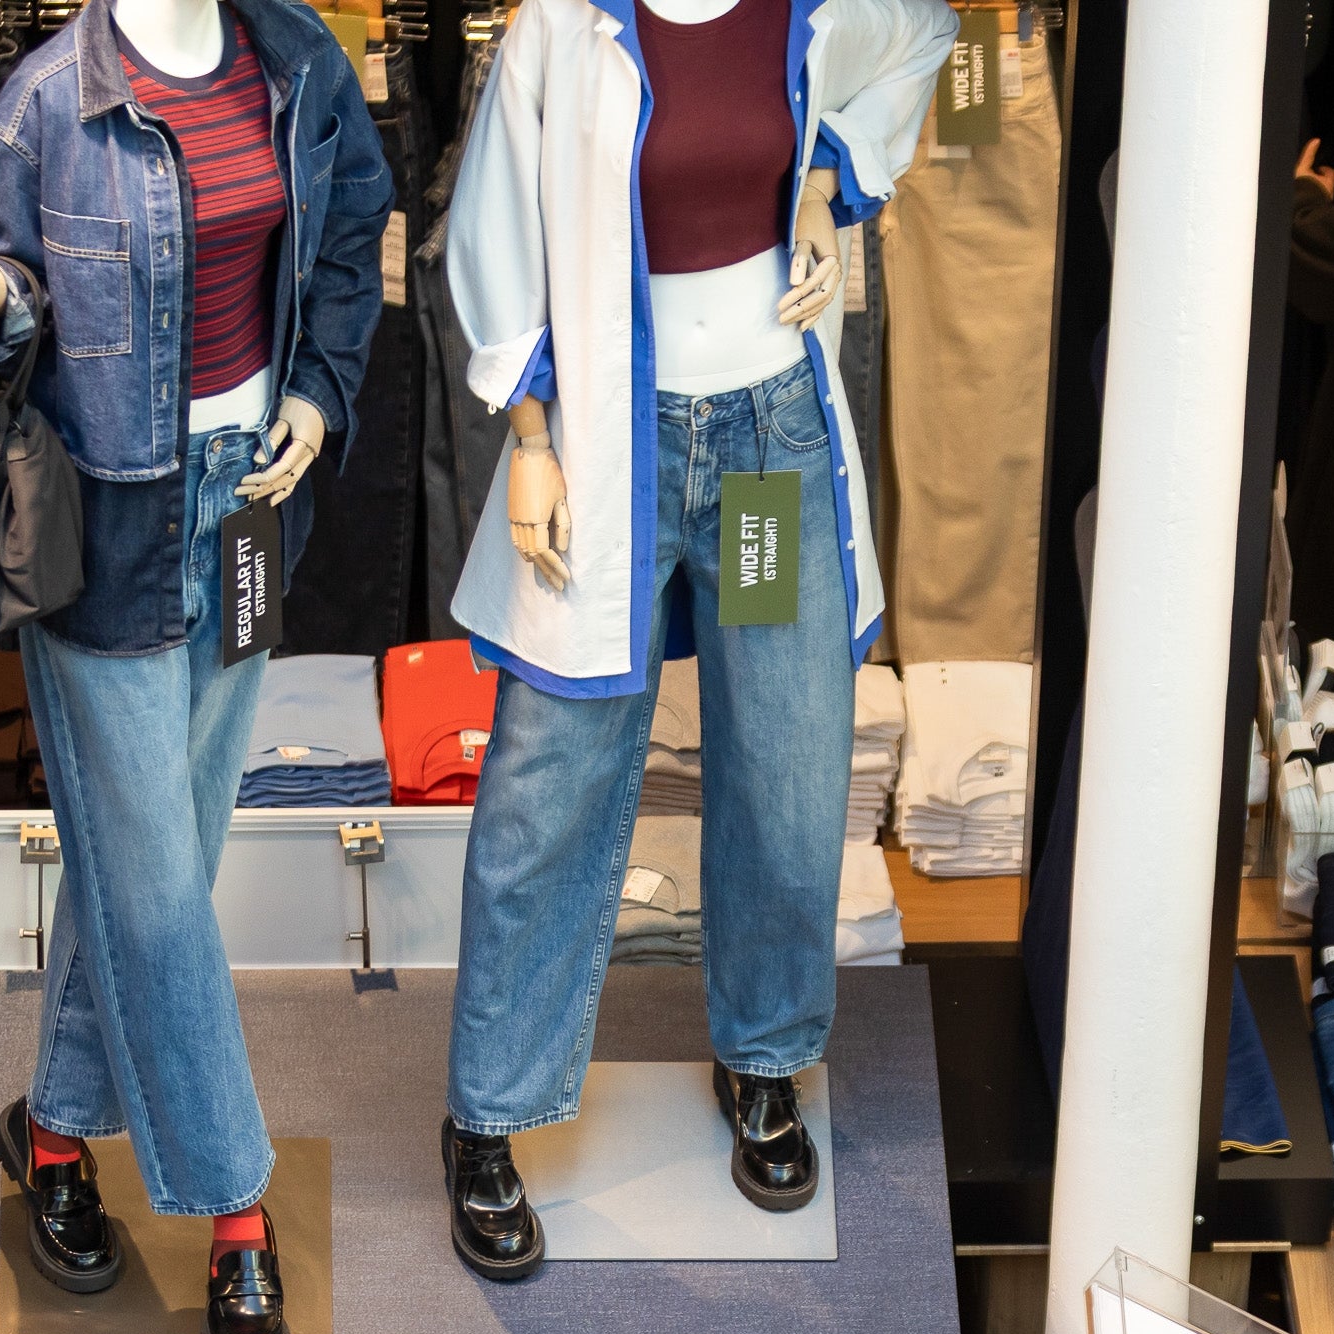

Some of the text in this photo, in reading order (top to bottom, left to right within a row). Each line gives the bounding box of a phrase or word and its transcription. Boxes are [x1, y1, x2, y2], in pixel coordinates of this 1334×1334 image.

[953, 40, 970, 111] WIDE FIT
[973, 44, 985, 104] (STRAIGHT)
[740, 513, 760, 588] WIDE FIT
[764, 517, 778, 581] (STRAIGHT)
[237, 537, 252, 648] REGULAR FIT
[255, 551, 266, 617] (STRAIGHT)
